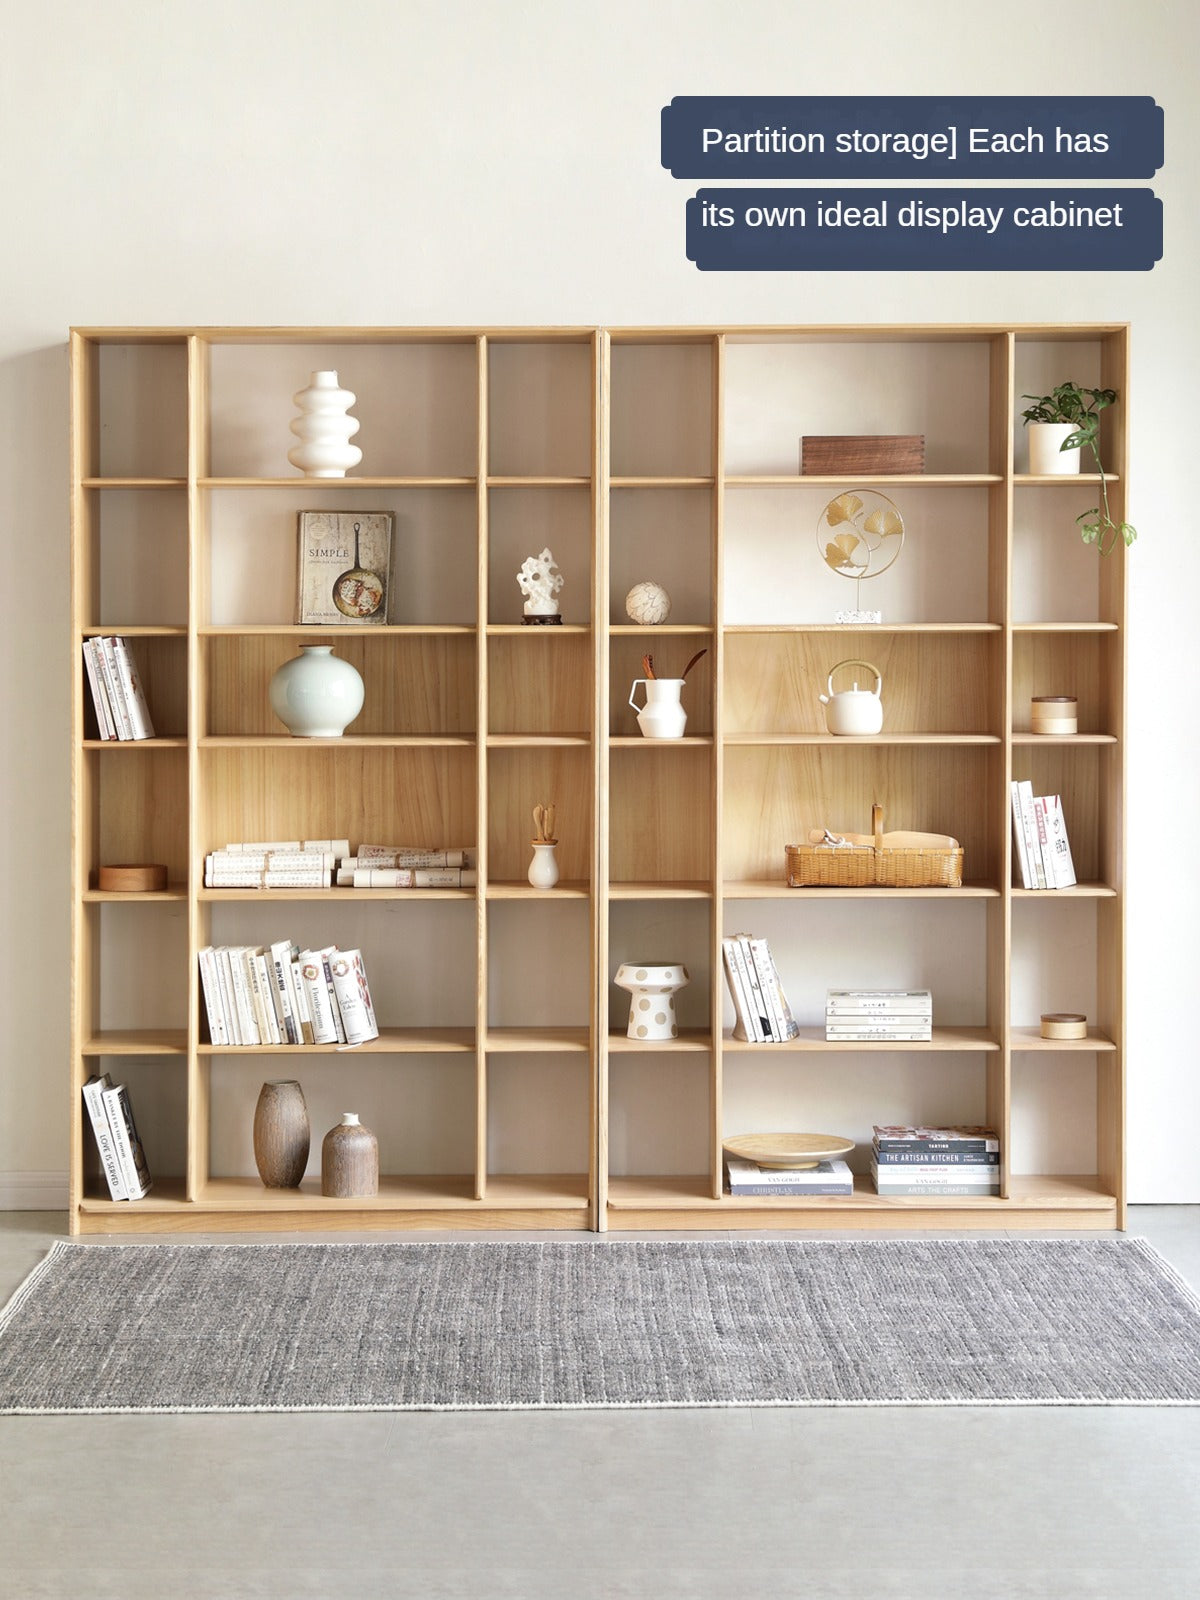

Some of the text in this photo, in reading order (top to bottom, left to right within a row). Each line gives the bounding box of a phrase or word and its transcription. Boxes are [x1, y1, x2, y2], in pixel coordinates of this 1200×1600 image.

[309, 549, 350, 558] SIMPLE
[100, 1134, 111, 1153] LOVE
[107, 1161, 119, 1186] SERVED
[886, 1154, 898, 1162] THE
[900, 1154, 929, 1162] ARTISAN
[931, 1154, 959, 1162] KITCHEN
